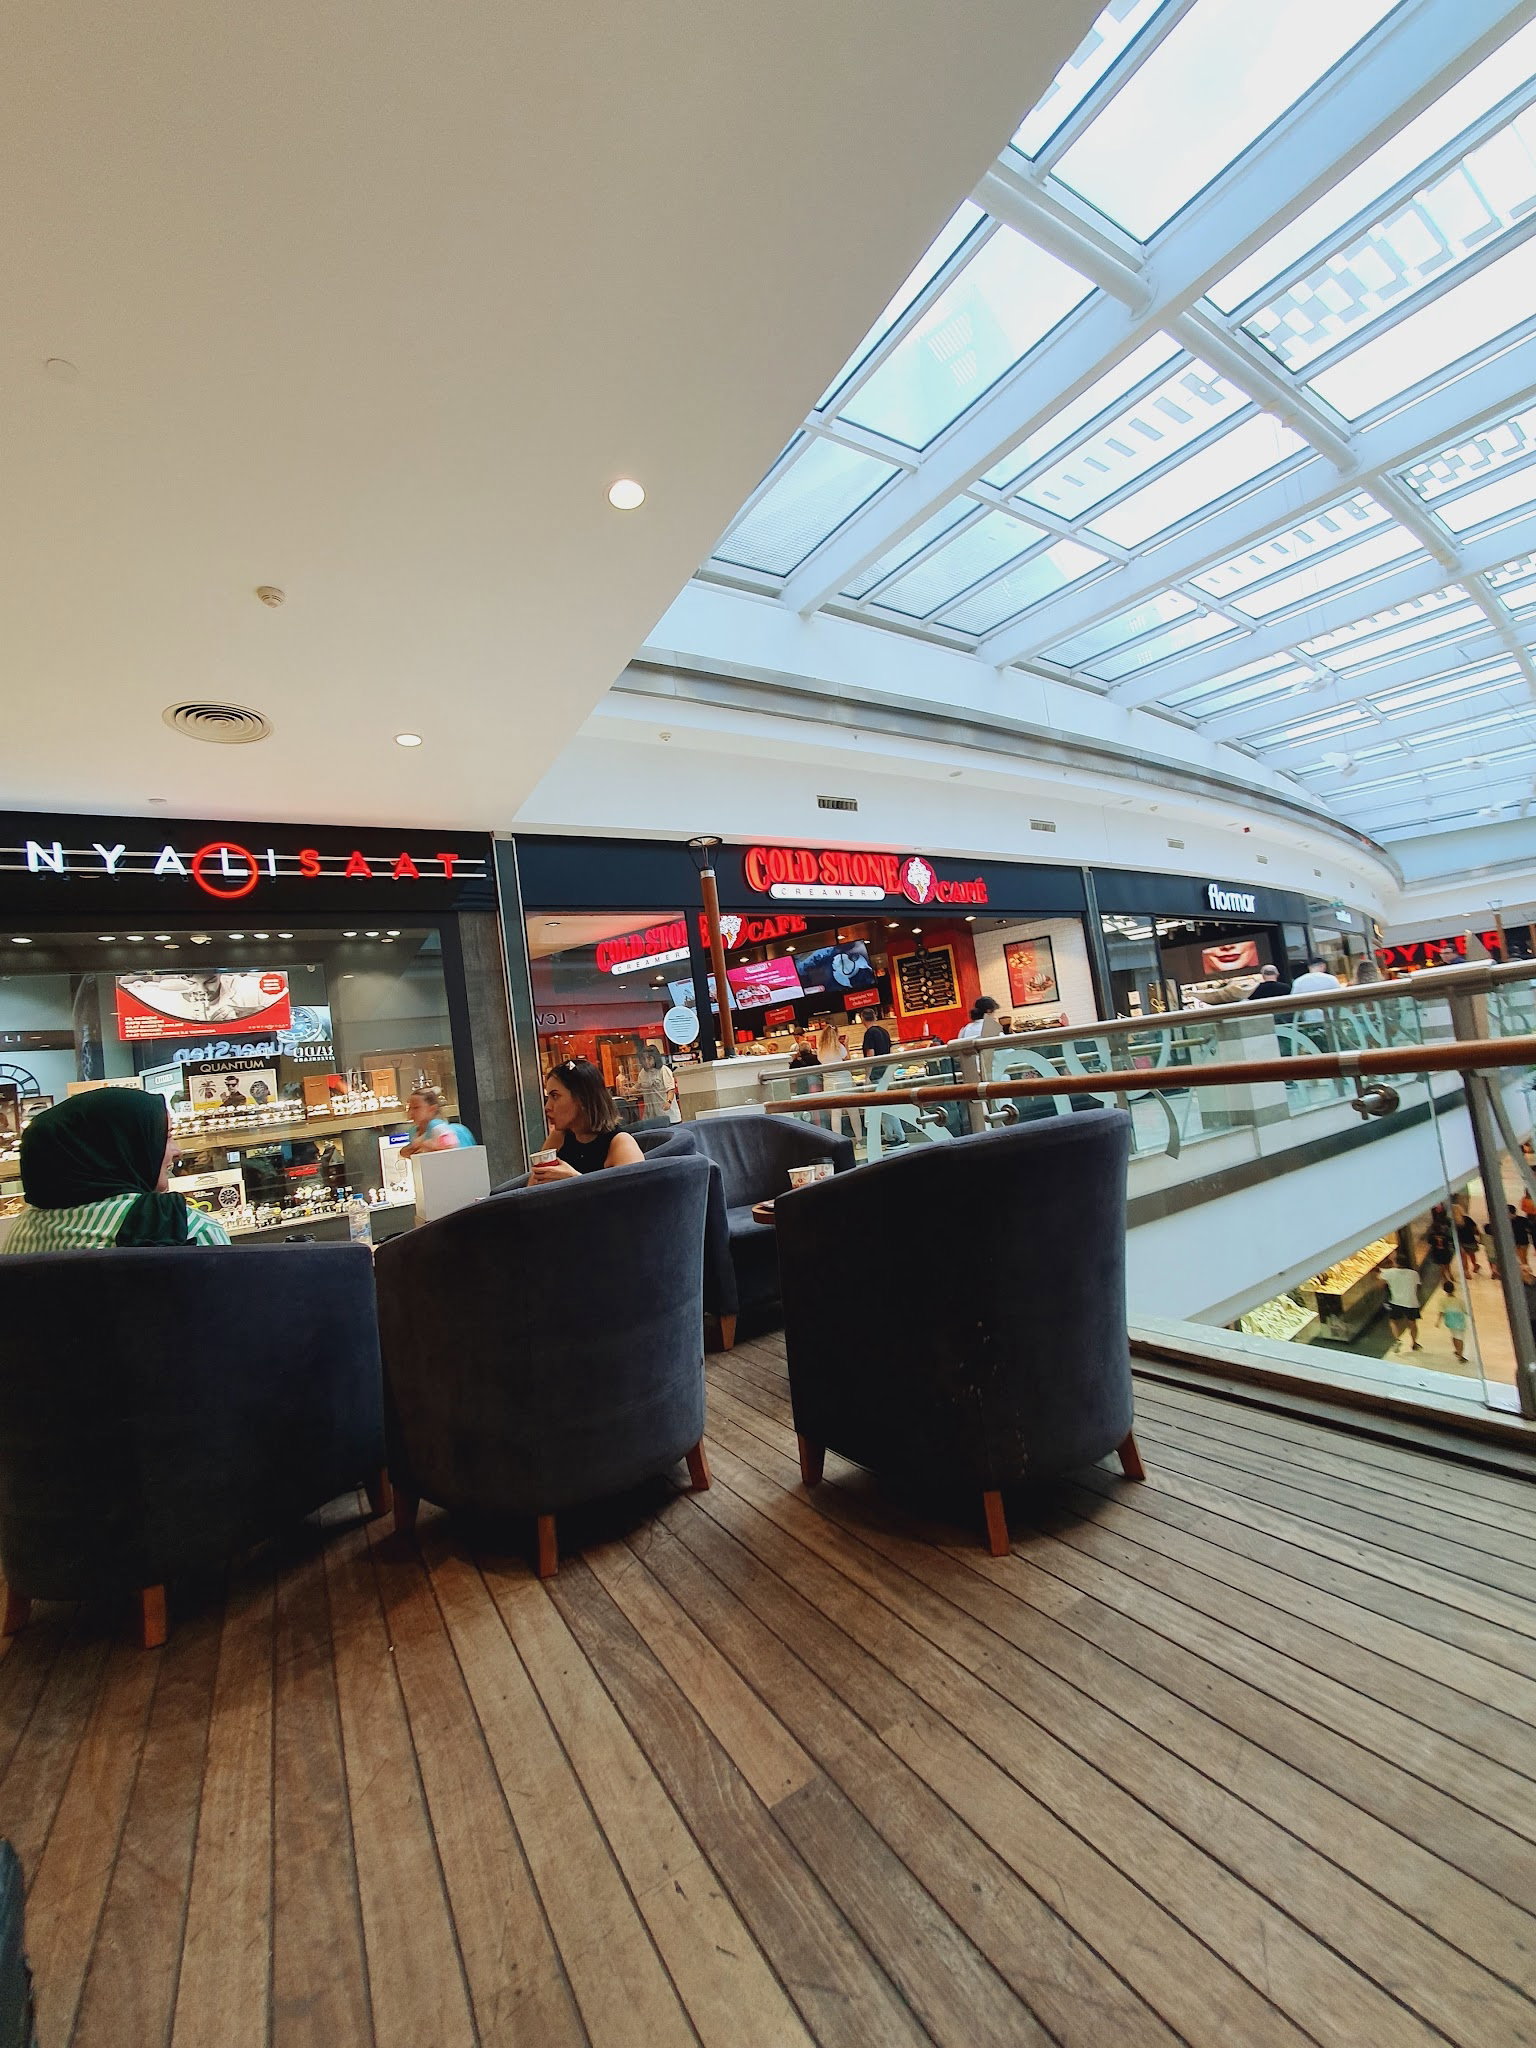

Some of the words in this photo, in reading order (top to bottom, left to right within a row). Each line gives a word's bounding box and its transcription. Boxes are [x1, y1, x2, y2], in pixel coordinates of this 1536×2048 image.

[299, 849, 459, 880] SAAT
[745, 848, 819, 892] COLD
[819, 852, 902, 894] STONE
[935, 877, 988, 903] CAFÉ
[781, 887, 878, 898] CREAMERY
[1208, 883, 1256, 913] flormar
[597, 935, 645, 972] COLD
[200, 1059, 265, 1073] QUANTUM
